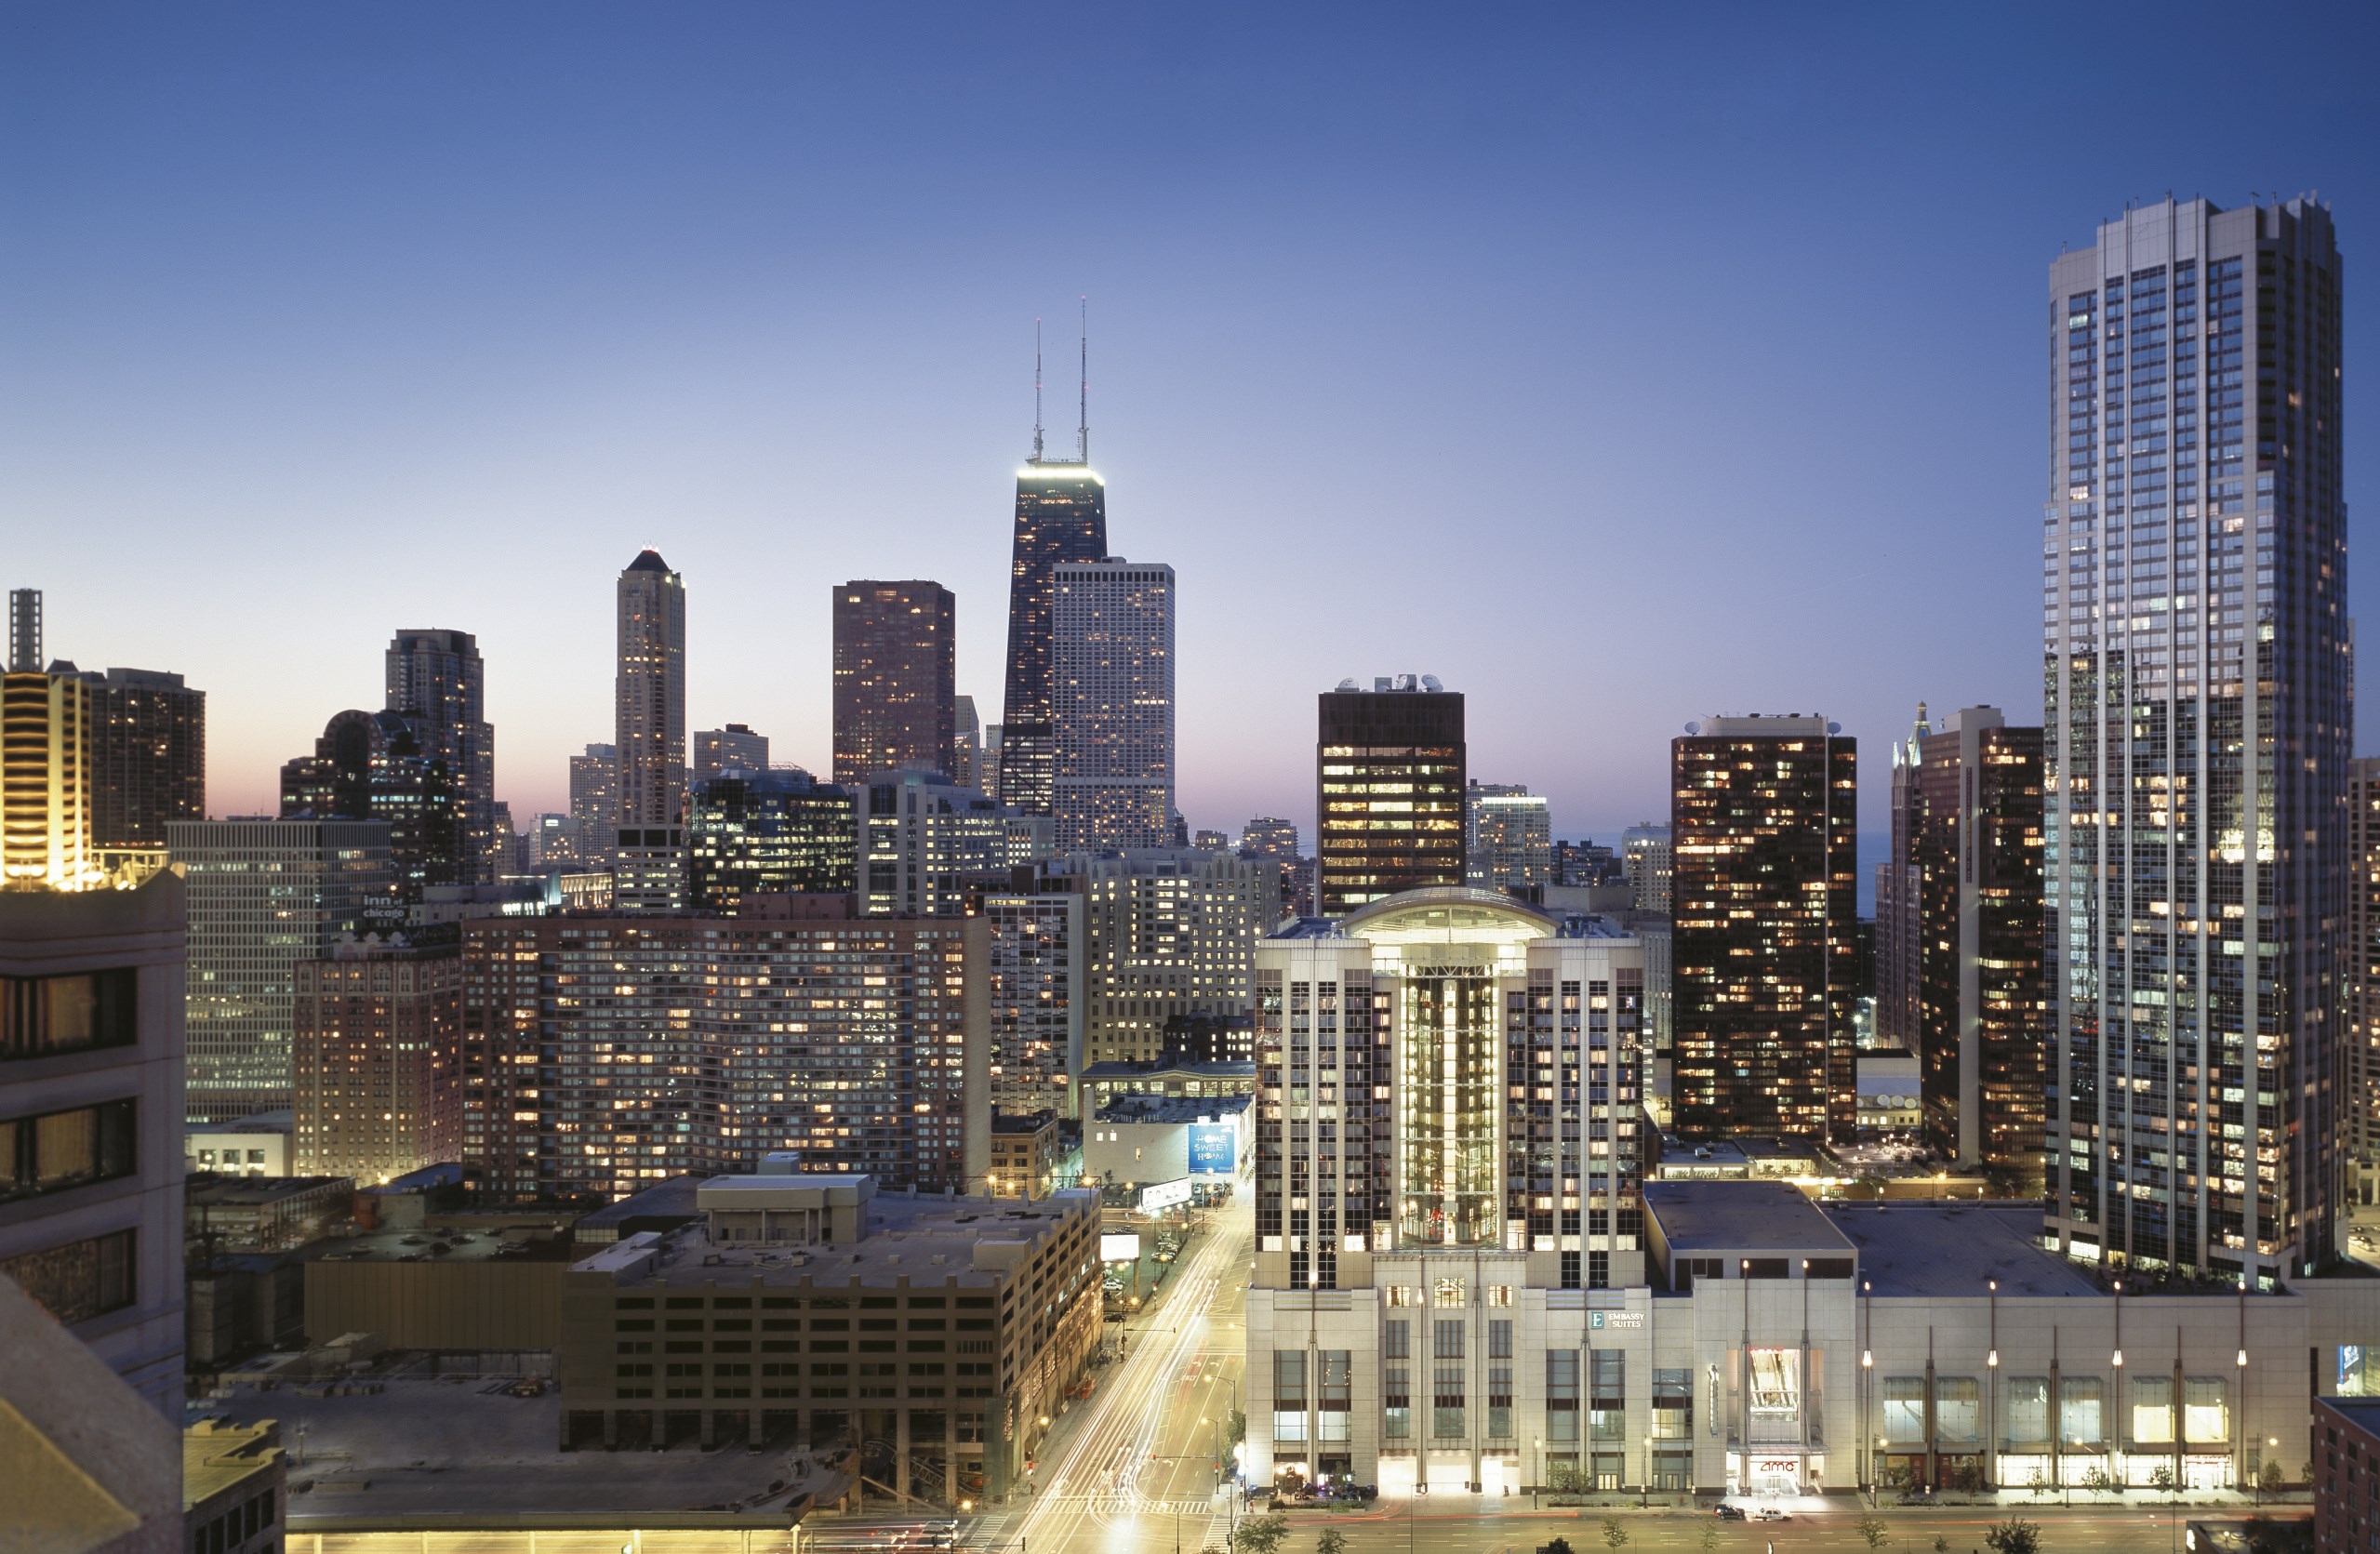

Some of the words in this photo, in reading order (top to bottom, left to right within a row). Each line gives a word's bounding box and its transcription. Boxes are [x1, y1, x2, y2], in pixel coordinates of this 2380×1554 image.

[364, 895, 391, 905] inn
[364, 908, 404, 919] chicago
[1196, 1135, 1227, 1143] HOME
